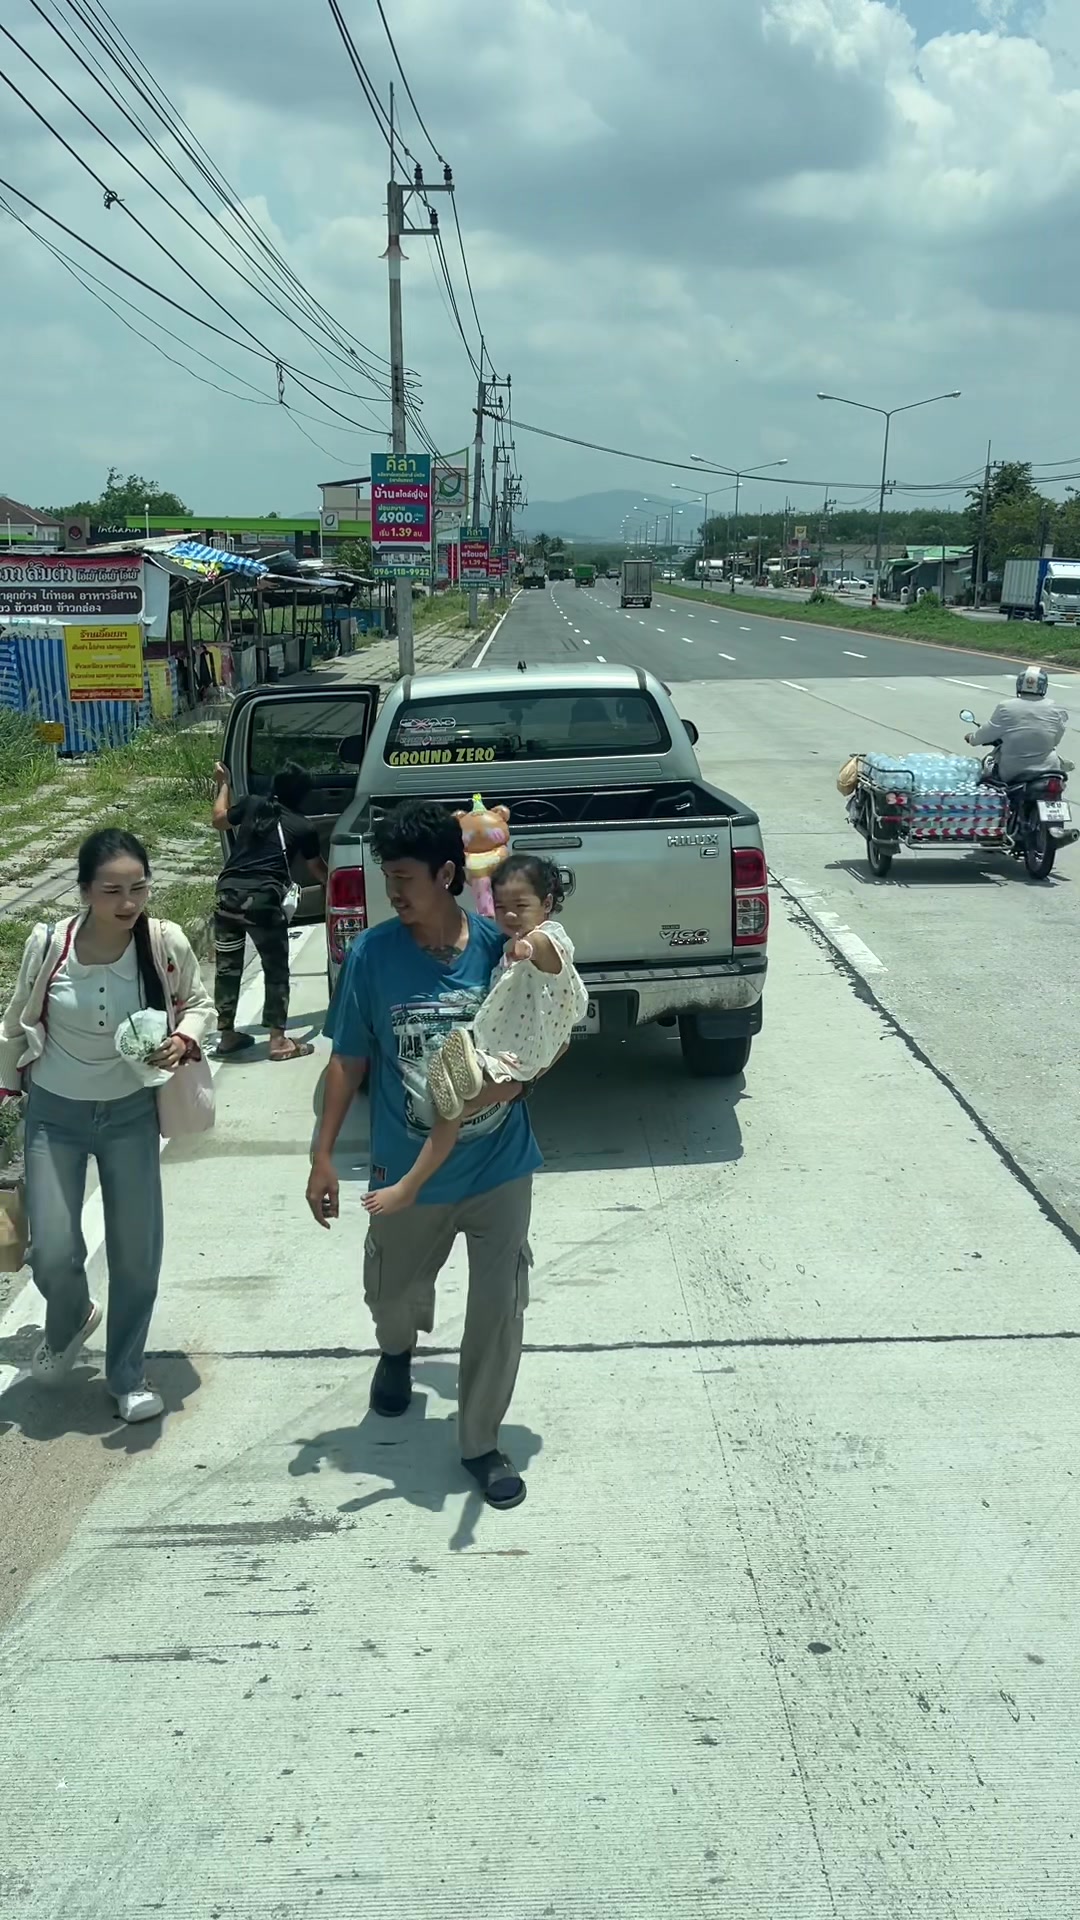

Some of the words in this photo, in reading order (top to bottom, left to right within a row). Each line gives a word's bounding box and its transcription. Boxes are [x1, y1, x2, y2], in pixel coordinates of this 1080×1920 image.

[386, 455, 416, 471] คีล่า
[97, 525, 142, 533] Inthanin
[391, 527, 412, 537] 1.39
[0, 566, 23, 581] ภา
[0, 589, 37, 603] าดุกย่าง
[40, 589, 75, 600] ไก่ทอด
[79, 590, 138, 600] อาหารอีสาน
[14, 602, 52, 612] ข้าวสวย
[56, 602, 102, 612] ข้าวกล่อง
[389, 750, 452, 765] GROUND
[455, 747, 495, 762] ZERO
[667, 834, 719, 846] HILUX
[659, 929, 710, 940] VIGO
